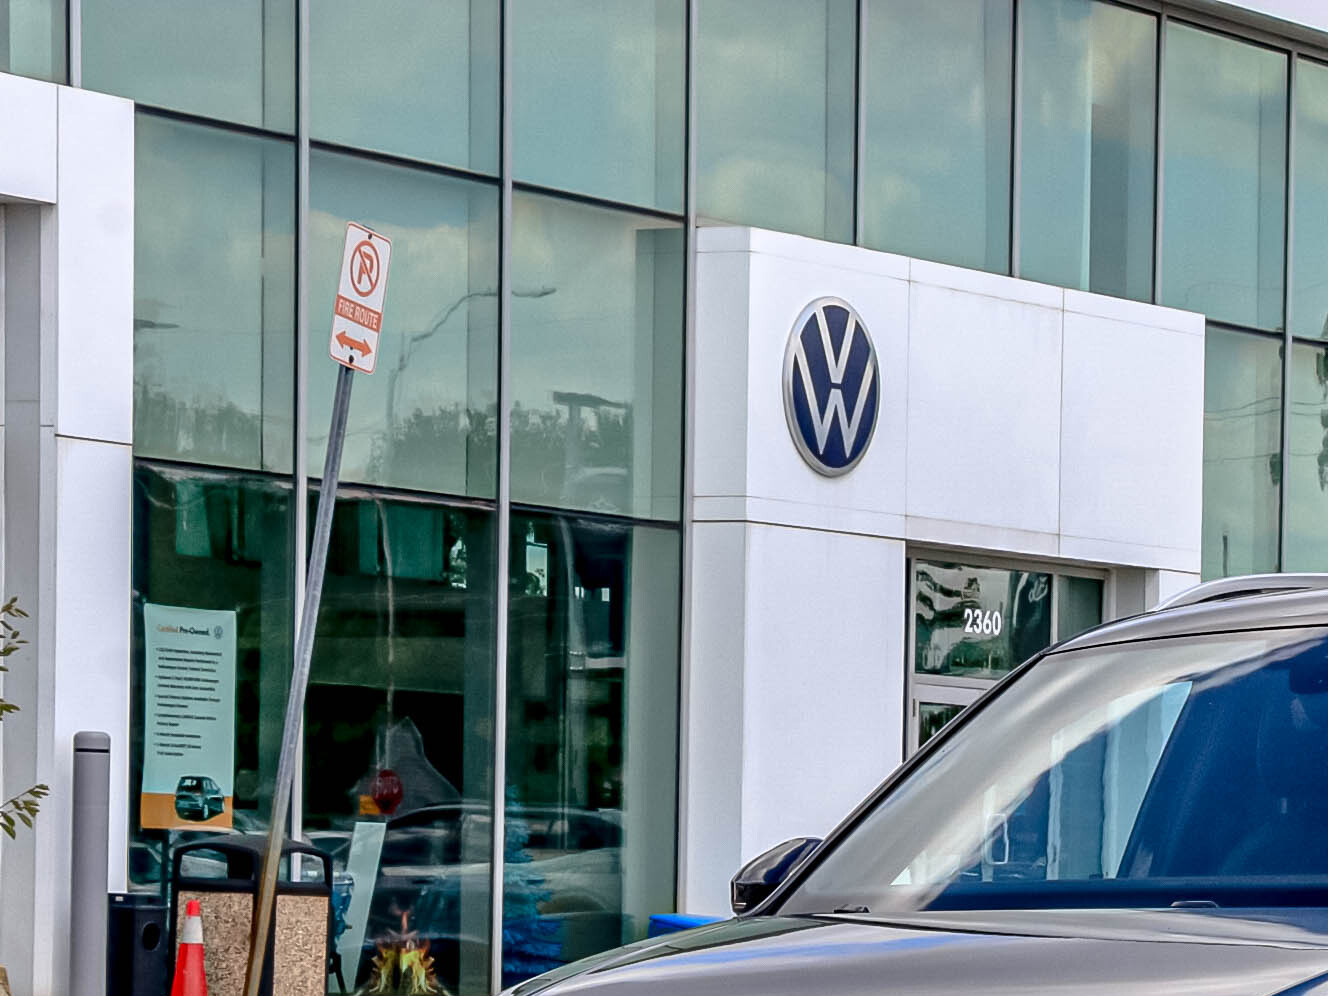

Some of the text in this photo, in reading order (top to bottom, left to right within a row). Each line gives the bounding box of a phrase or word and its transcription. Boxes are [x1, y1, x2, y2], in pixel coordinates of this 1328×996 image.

[338, 299, 378, 329] FIRE ROUTE
[963, 608, 1002, 635] 2360
